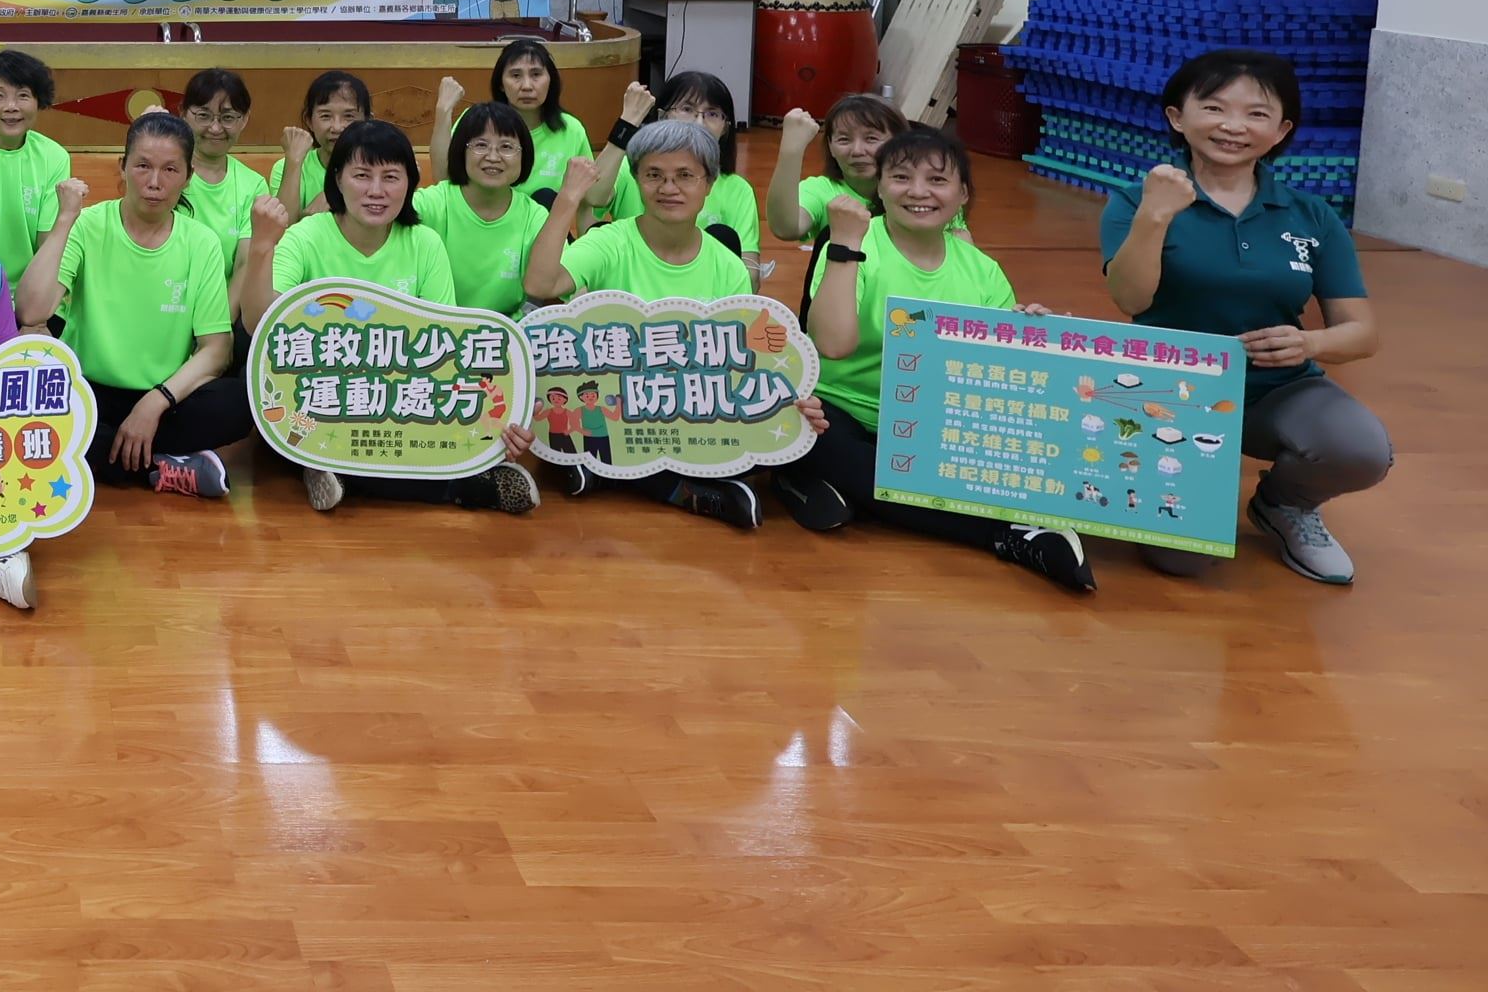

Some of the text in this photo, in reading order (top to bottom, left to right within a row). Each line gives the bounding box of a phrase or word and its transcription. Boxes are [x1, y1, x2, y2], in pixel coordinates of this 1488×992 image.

[272, 326, 506, 371] 搶救肌少症
[528, 322, 749, 371] 強健長肌
[933, 314, 1232, 370] 預防骨鬆 飲食運動3+1
[944, 360, 1049, 387] 豐富蛋白質
[298, 374, 483, 419] 運動處方
[624, 371, 793, 418] 防肌少
[943, 391, 1070, 422] 足量鈣質攝取
[350, 429, 404, 439] 嘉義縣政府
[350, 439, 404, 448] 嘉義縣衛生局
[439, 440, 457, 449] 廣告
[623, 428, 680, 437] 嘉義縣政府
[624, 436, 681, 446] 嘉義縣衛生局
[941, 426, 1061, 458] 補充維生素D
[350, 448, 404, 458] 南華大學
[625, 446, 682, 455] 南華大學
[938, 461, 1066, 496] 搭配規律運動
